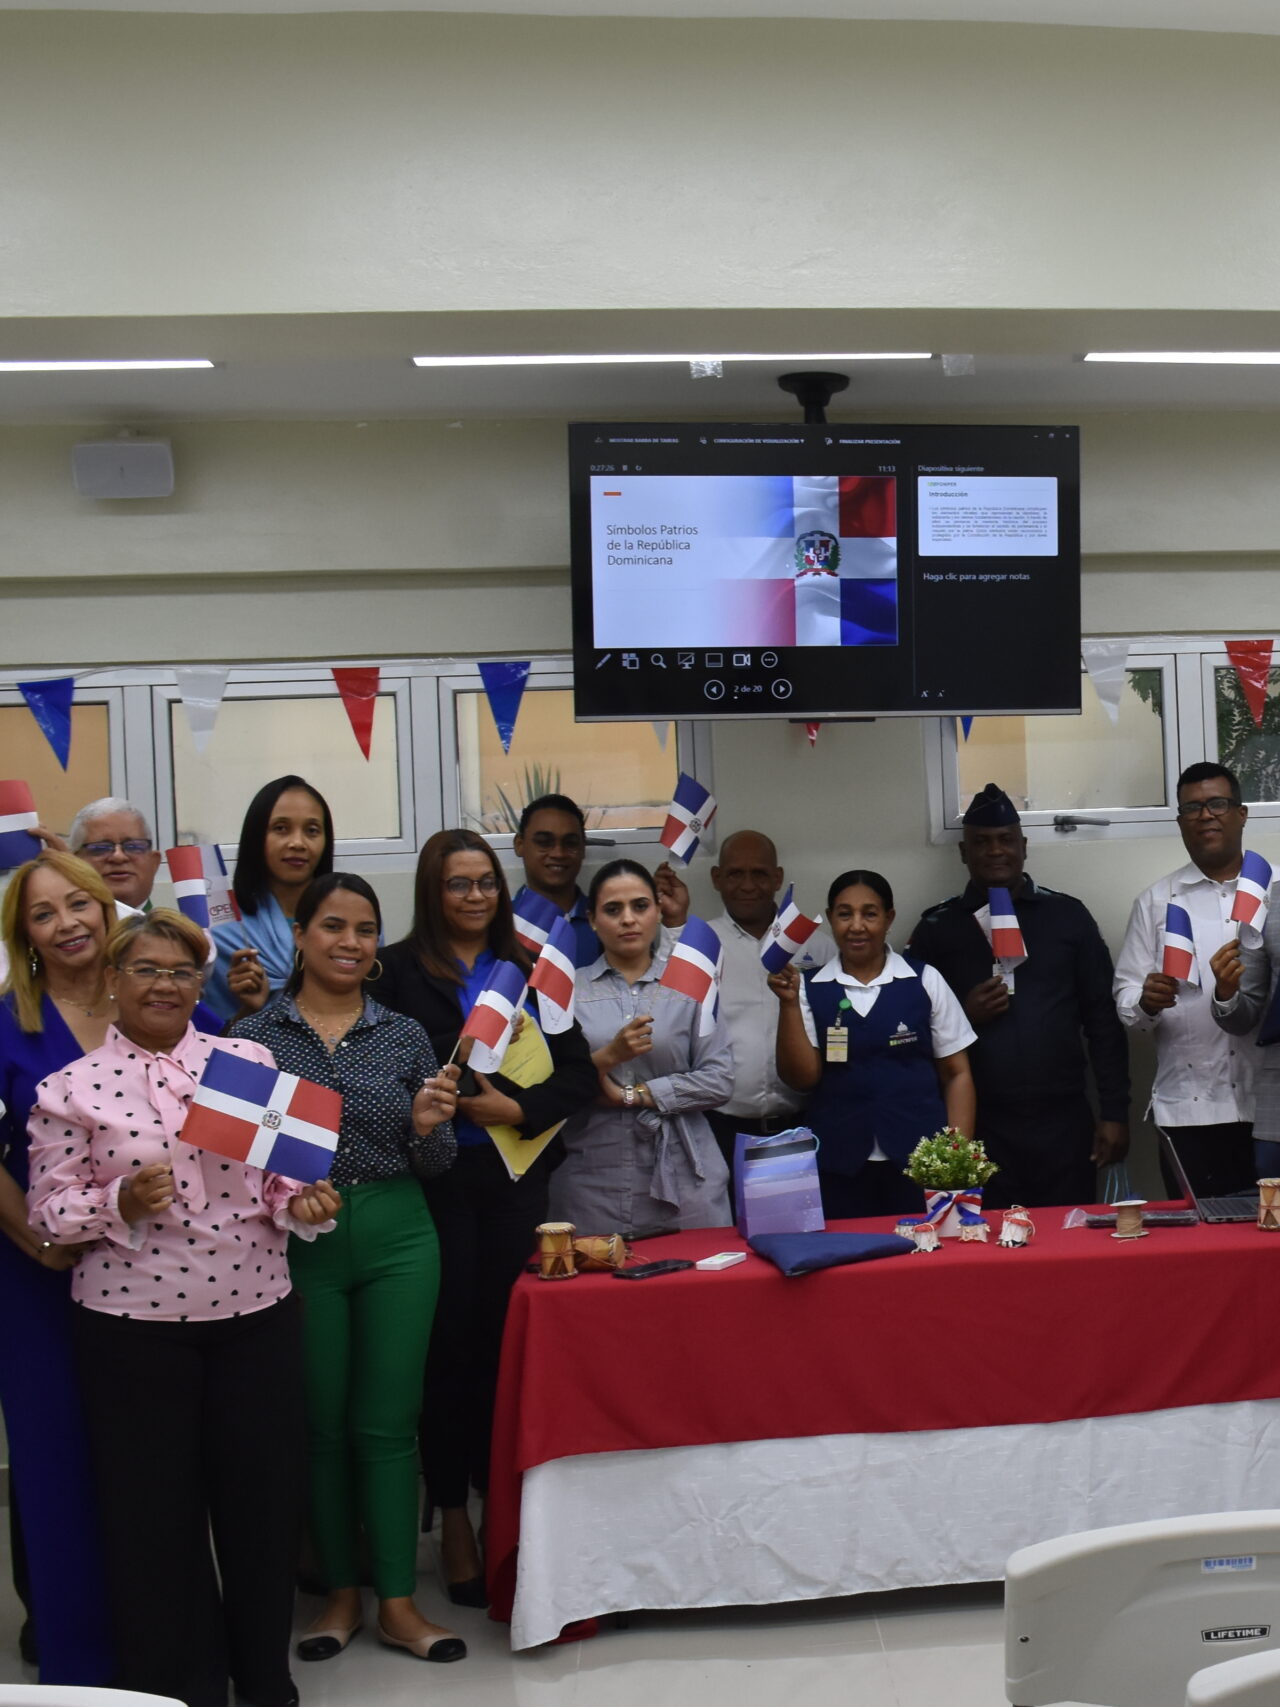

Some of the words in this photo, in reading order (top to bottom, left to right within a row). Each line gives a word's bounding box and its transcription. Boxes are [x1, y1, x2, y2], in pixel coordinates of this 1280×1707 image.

[878, 465, 896, 473] 11:13
[955, 465, 985, 473] siguiente
[606, 524, 657, 535] Símbolos
[660, 524, 699, 535] Patrios
[607, 540, 621, 550] de
[624, 539, 634, 550] la
[637, 539, 691, 552] República
[607, 554, 673, 566] Dominicana
[923, 572, 944, 582] Haga
[945, 572, 958, 580] clic
[959, 574, 977, 582] para
[978, 574, 1007, 582] agregar
[733, 685, 740, 693] 2
[740, 684, 751, 693] de
[752, 684, 763, 693] 20
[1210, 1628, 1262, 1639] LIFETIME
